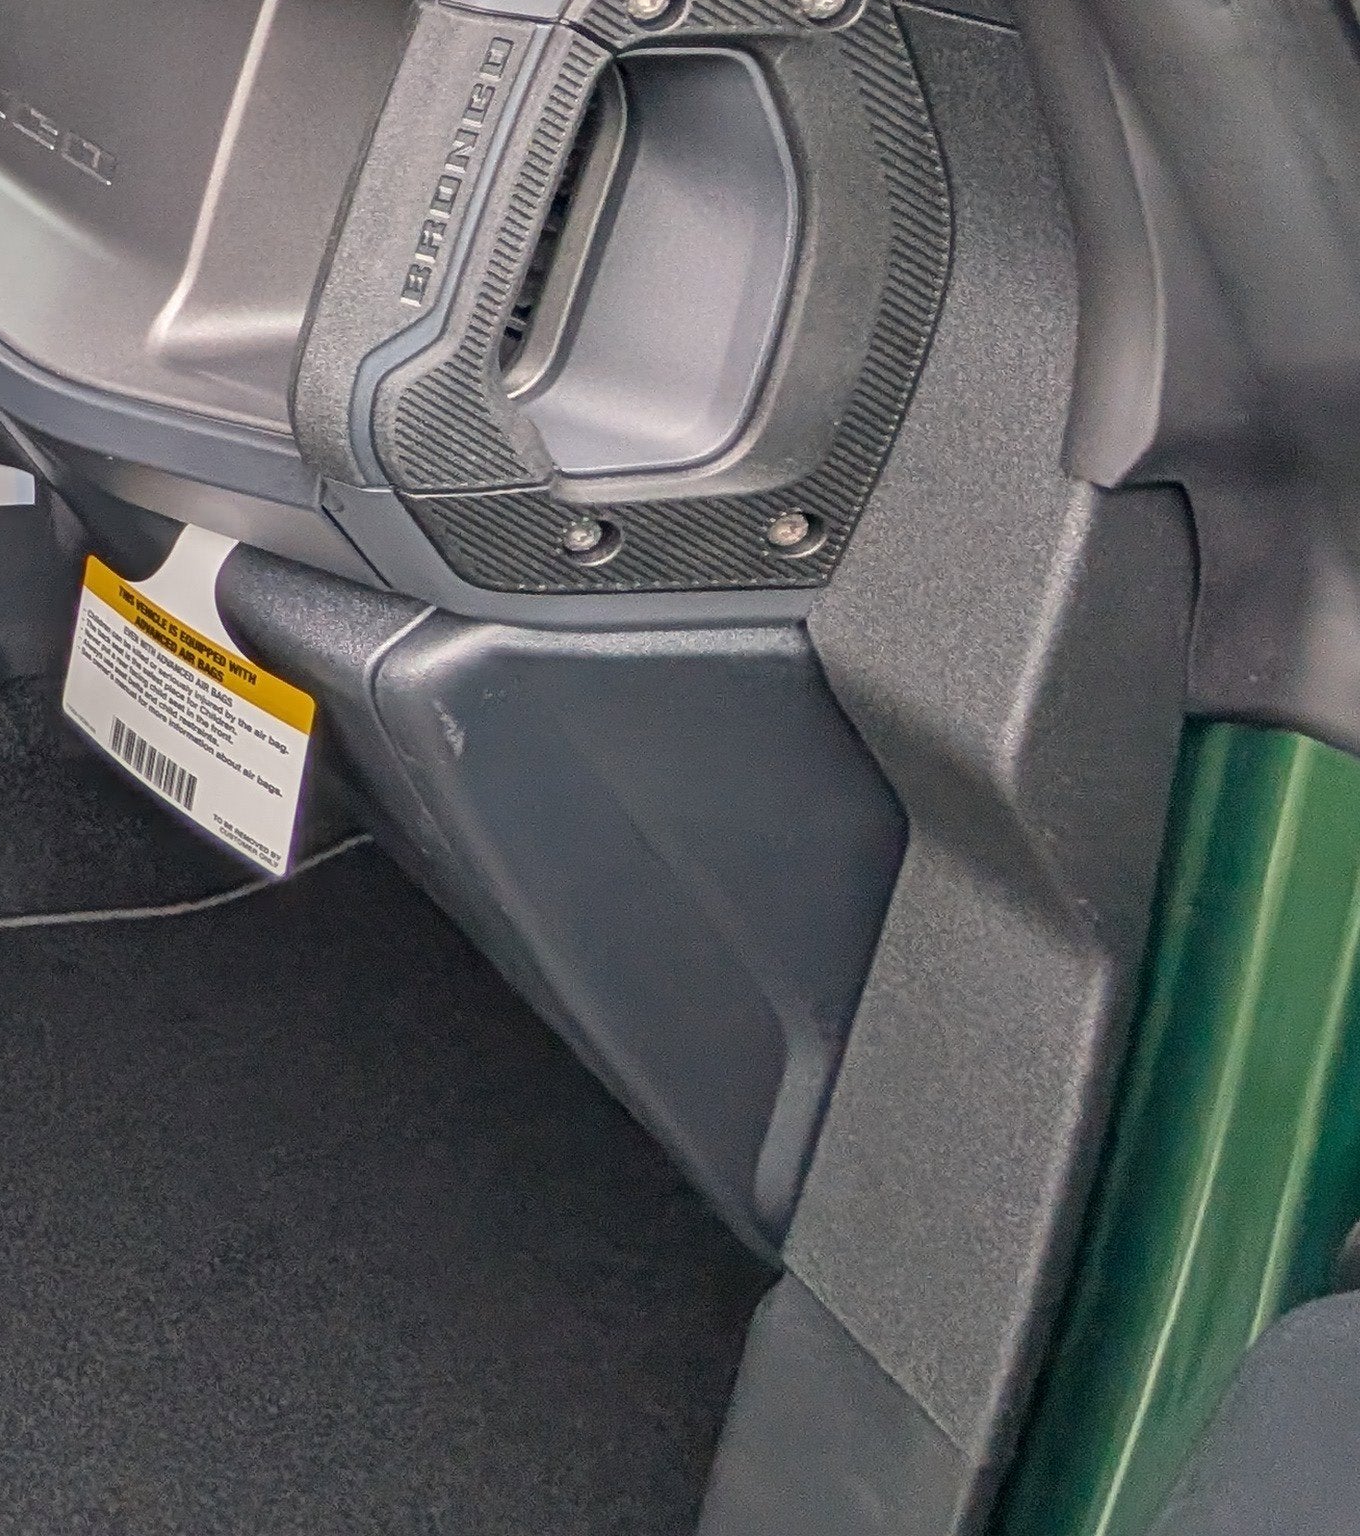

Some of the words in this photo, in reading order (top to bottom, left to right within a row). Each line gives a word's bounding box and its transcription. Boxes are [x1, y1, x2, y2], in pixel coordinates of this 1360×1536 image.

[398, 35, 516, 309] BRONCO
[118, 584, 135, 606] THIS
[135, 598, 167, 630] VEHICLE
[168, 622, 178, 637] IS
[179, 629, 226, 668] EQUIPPED
[228, 659, 257, 686] WITH
[134, 614, 177, 653] ADVANCED
[179, 646, 195, 664] AIR
[197, 657, 224, 683] BAGS
[149, 682, 167, 700] child
[195, 713, 209, 728] the
[210, 723, 233, 744] front.
[158, 700, 177, 718] child
[158, 666, 192, 696] seriously
[237, 717, 252, 732] the
[268, 735, 289, 758] bag.
[164, 681, 184, 701] place
[199, 704, 238, 736] Children.
[195, 677, 209, 693] AIR
[210, 686, 233, 708] BAGS
[148, 703, 167, 723] more
[168, 718, 214, 754] information
[215, 749, 241, 772] about
[256, 774, 282, 800] bags.
